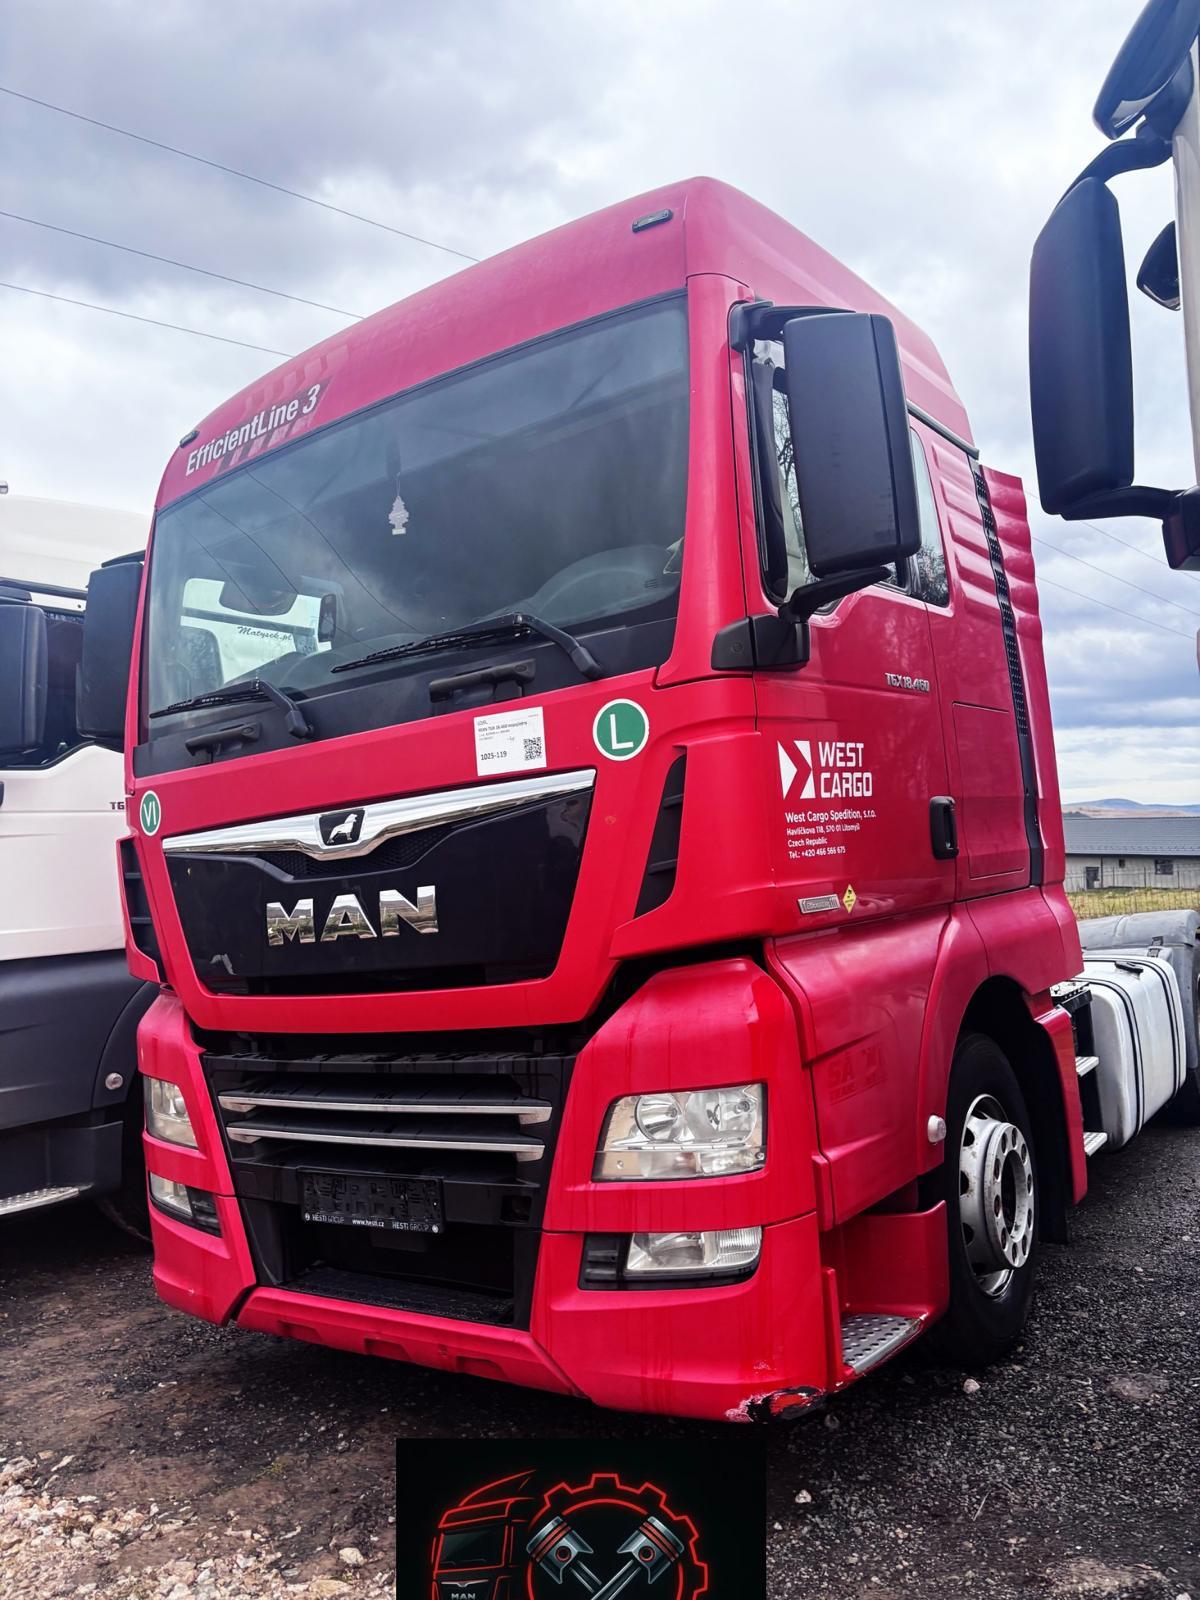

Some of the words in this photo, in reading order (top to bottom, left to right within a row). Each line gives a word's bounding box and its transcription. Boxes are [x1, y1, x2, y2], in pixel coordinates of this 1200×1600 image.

[185, 399, 299, 476] EfficientLine
[302, 384, 321, 414] 3
[610, 713, 634, 750] L
[480, 750, 508, 761] 1025-119
[818, 741, 865, 768] WEST
[820, 772, 873, 798] CARGO
[785, 812, 806, 823] West
[807, 810, 829, 823] Cargo
[830, 808, 863, 822] Spedition,
[863, 809, 877, 818] s.r.o.
[787, 839, 805, 848] Czech
[266, 885, 440, 946] MAN
